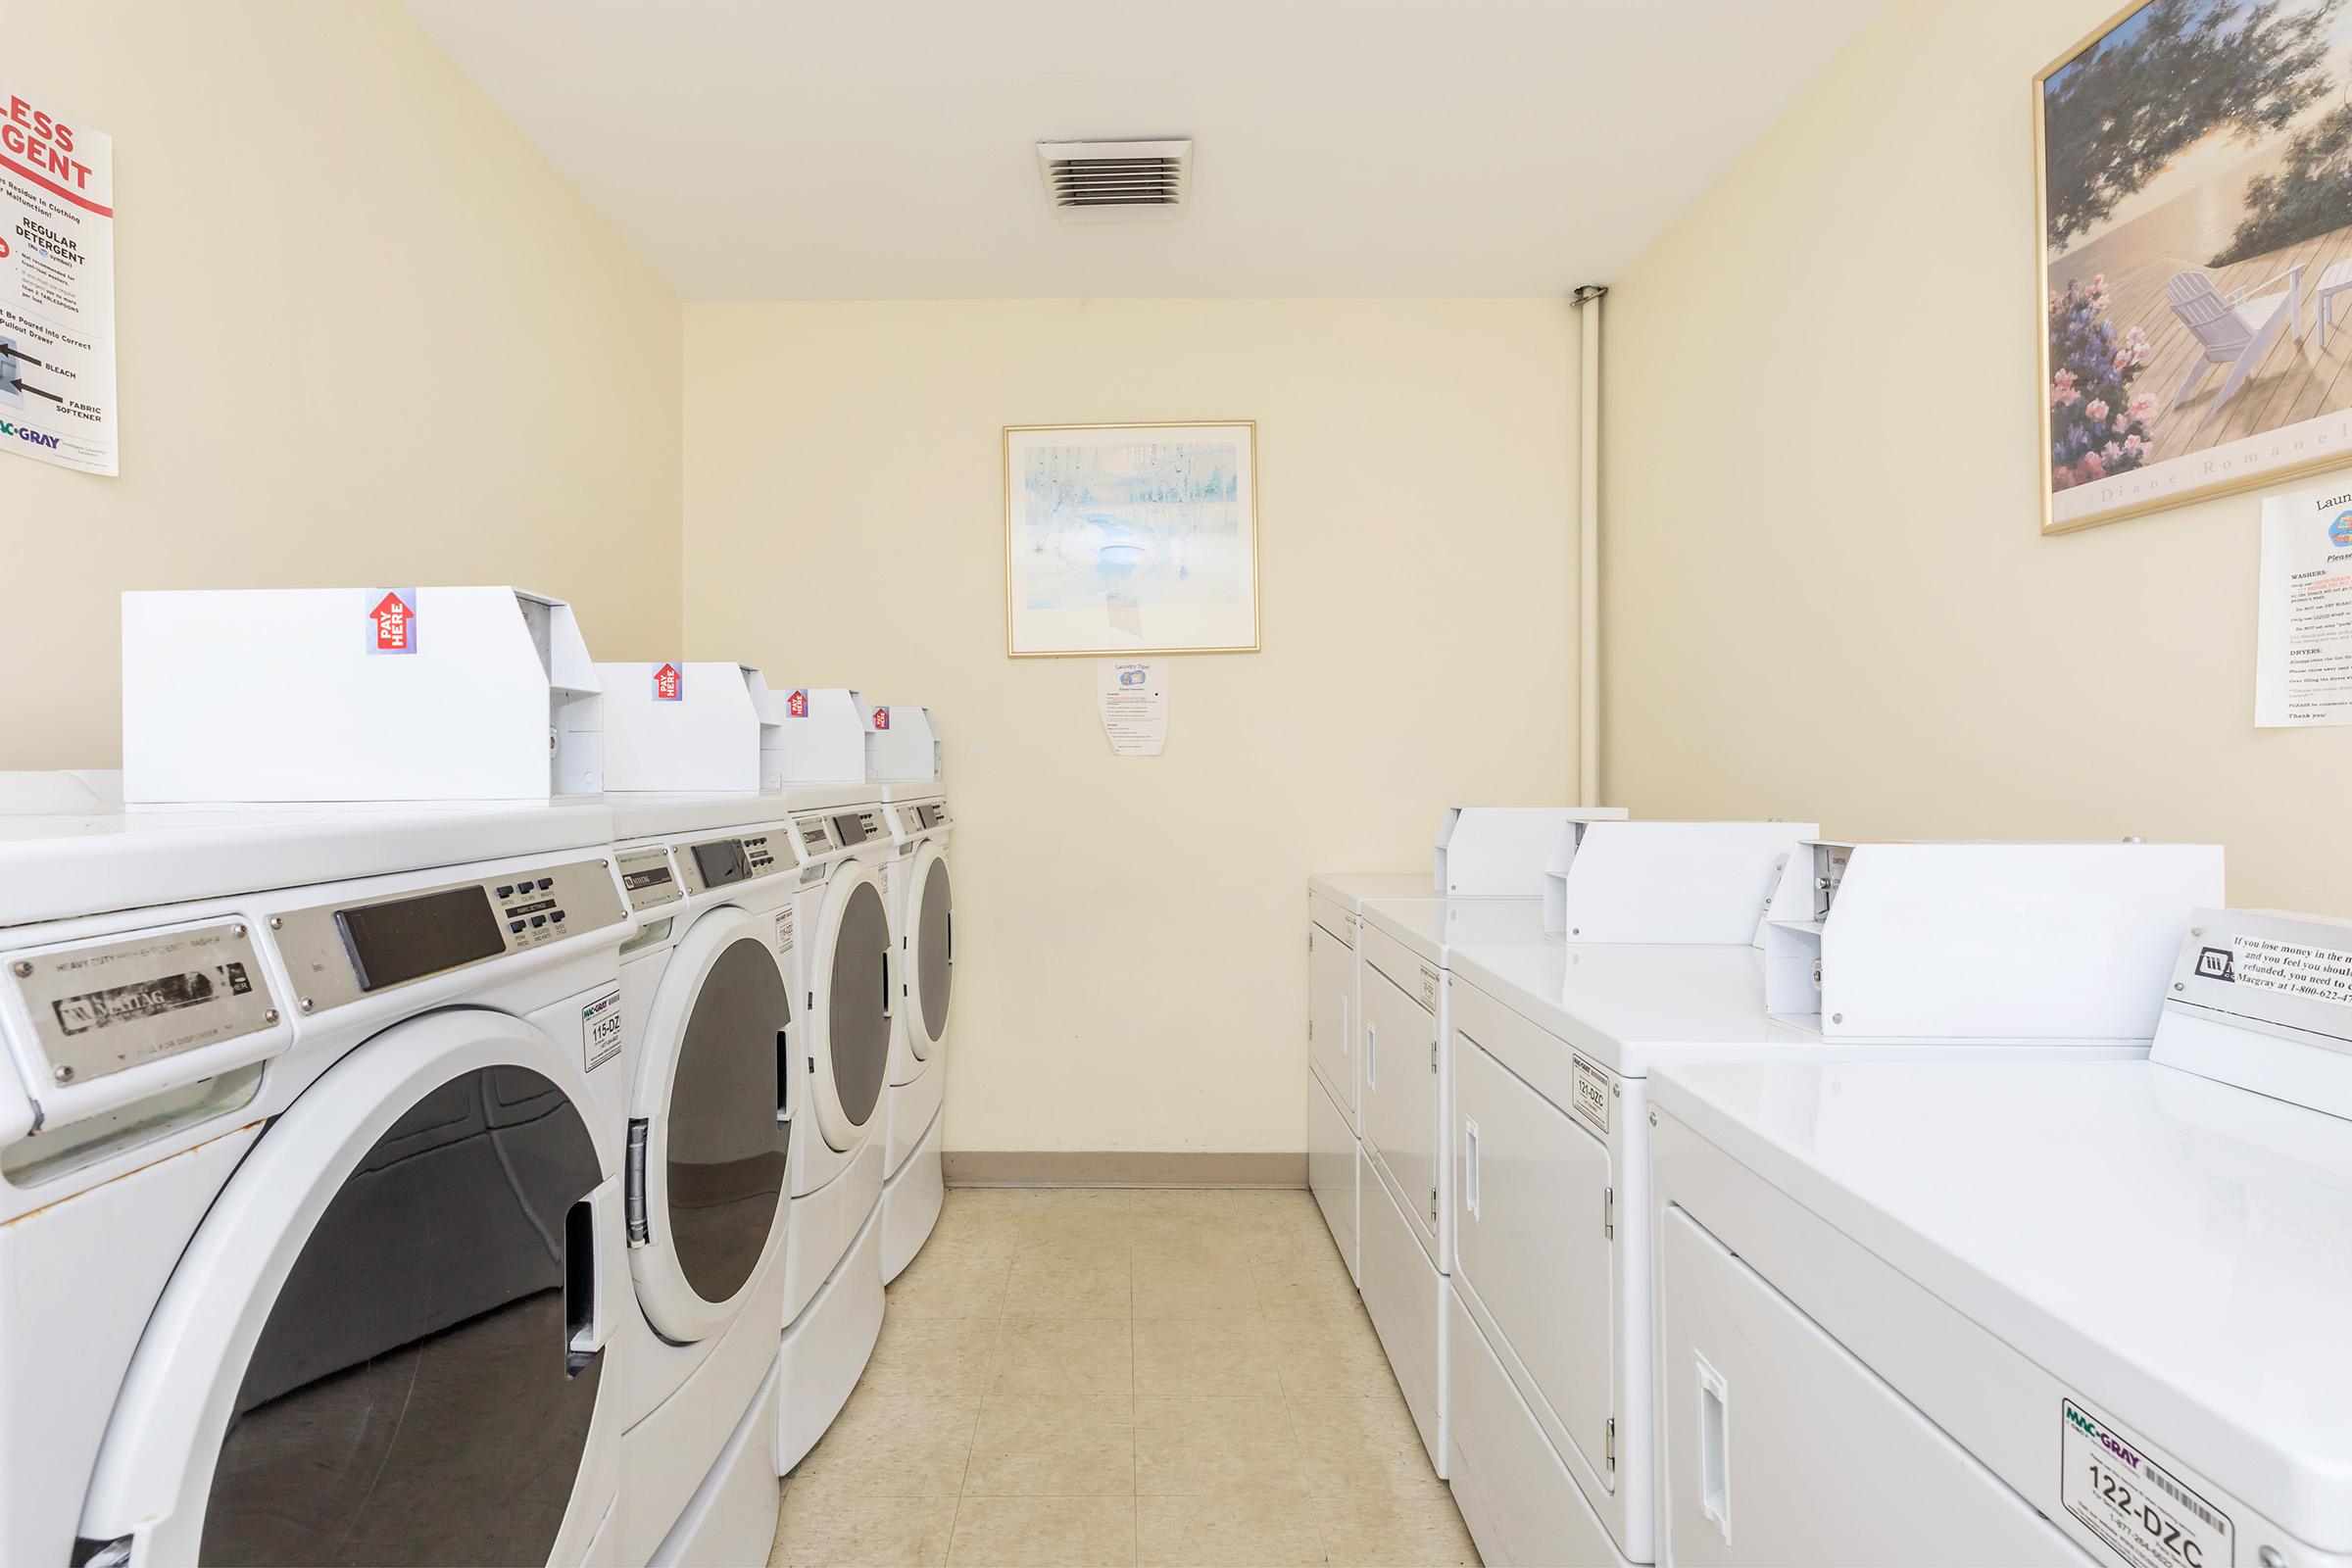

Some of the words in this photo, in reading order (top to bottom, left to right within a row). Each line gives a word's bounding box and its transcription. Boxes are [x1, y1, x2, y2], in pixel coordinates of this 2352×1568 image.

[2, 124, 92, 189] GENT
[6, 189, 52, 219] Malfunction!
[8, 180, 37, 202] Residue
[39, 198, 47, 207] In
[49, 203, 80, 224] Clothing
[16, 224, 85, 266] DETERGENT
[23, 217, 77, 251] REGULAR
[40, 293, 79, 314] TABLESPOONS
[6, 311, 17, 321] Be
[18, 316, 43, 332] Poured
[45, 327, 60, 339] Into
[61, 334, 91, 351] Correct
[28, 330, 54, 346] Drawer
[45, 363, 76, 379] BLEACH
[56, 404, 102, 422] SOFTENER
[69, 400, 102, 416] FABRIC
[2101, 473, 2178, 503] Diane
[2316, 493, 2352, 511] Laun
[380, 611, 391, 639] PAY
[391, 603, 404, 646] HERE
[90, 955, 115, 966] UTY
[2234, 936, 2242, 946] If
[2243, 940, 2260, 949] you
[2261, 941, 2279, 952] lose
[2280, 946, 2313, 958] money
[2315, 949, 2325, 959] in
[2327, 952, 2343, 962] the
[2264, 955, 2280, 964] you
[2282, 956, 2301, 968] feel
[2302, 961, 2321, 972] you
[2236, 972, 2275, 990] Macgray
[2278, 982, 2288, 991] at
[2290, 983, 2352, 1004] 1-800-622-47
[2288, 971, 2307, 981] you
[2309, 975, 2331, 986] need
[2333, 979, 2345, 989] to
[1578, 1079, 1603, 1107] 121-DZC
[2089, 1465, 2202, 1568] 122-DZC
